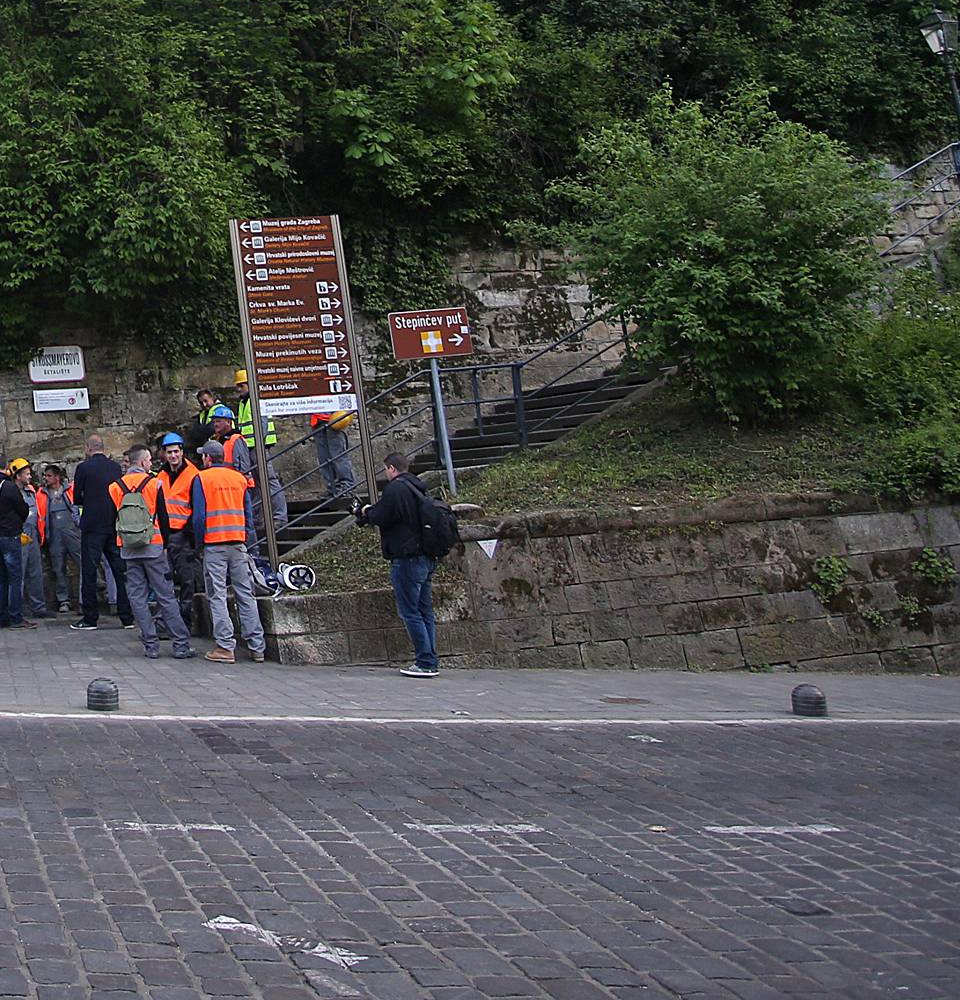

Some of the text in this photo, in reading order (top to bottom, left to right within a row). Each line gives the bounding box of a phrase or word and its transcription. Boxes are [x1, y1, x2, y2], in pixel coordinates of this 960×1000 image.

[298, 218, 320, 226] Zagreba
[395, 312, 462, 329] Stepinčev put
[276, 349, 306, 357] prekinutih
